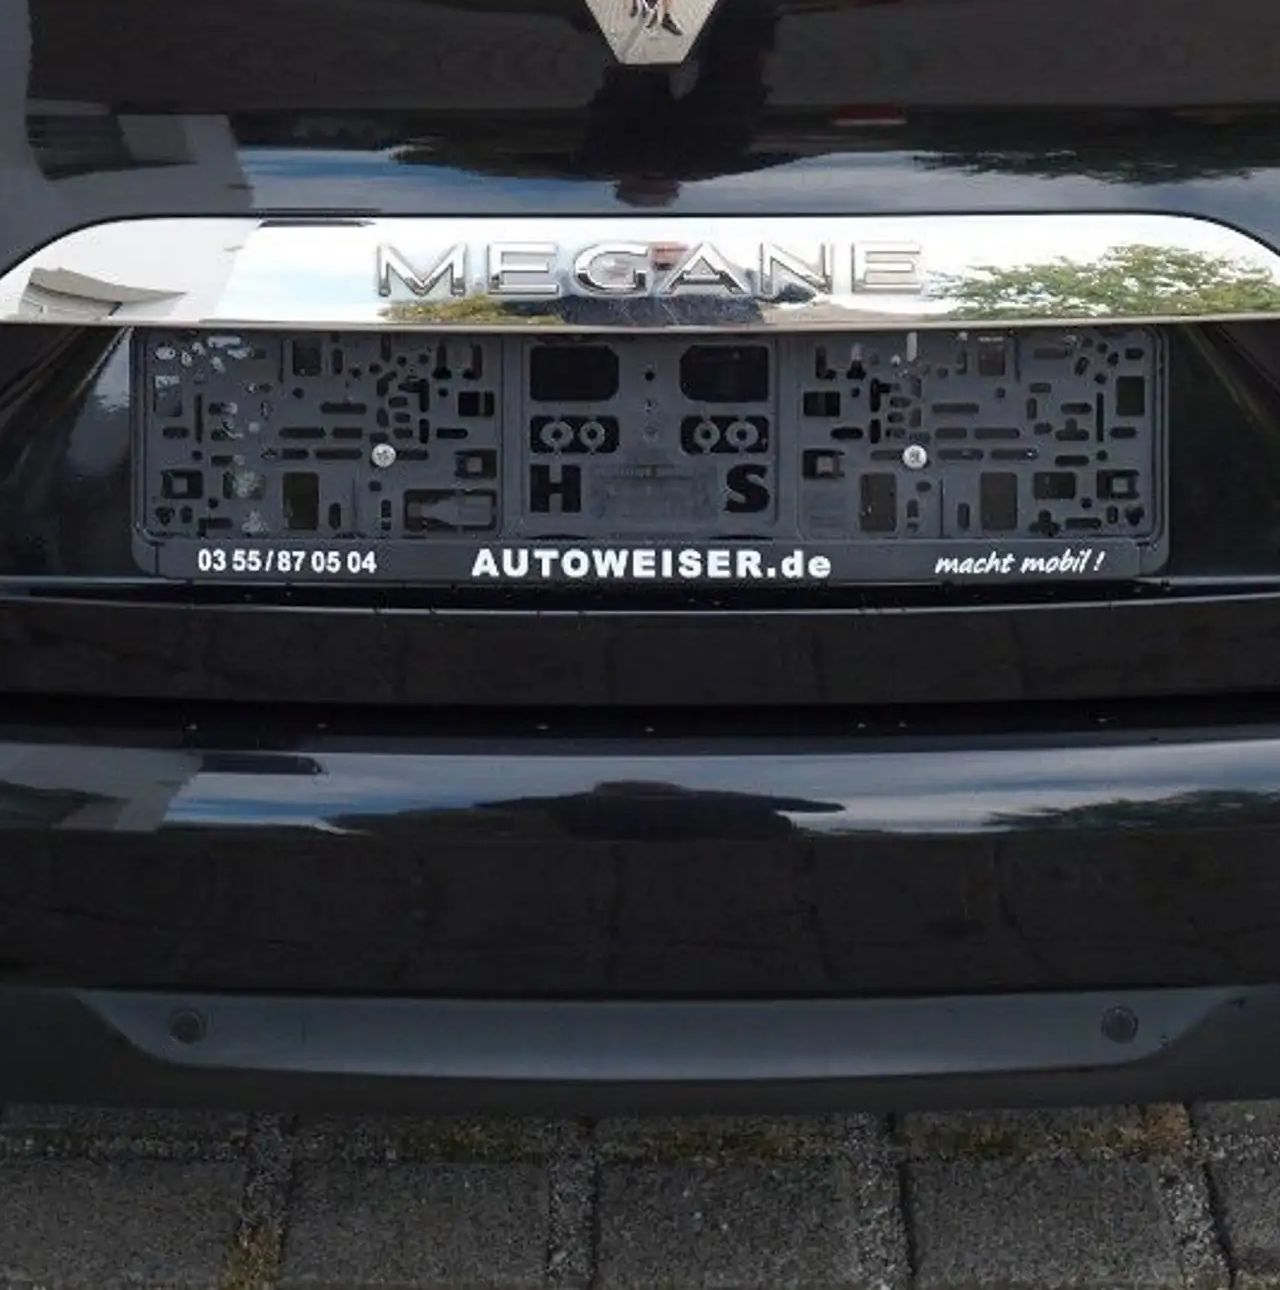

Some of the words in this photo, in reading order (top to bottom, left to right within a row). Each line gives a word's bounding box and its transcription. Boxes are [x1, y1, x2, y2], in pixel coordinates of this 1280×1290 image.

[376, 240, 921, 297] MEGANE
[529, 464, 582, 513] H
[723, 464, 770, 513] S
[198, 548, 227, 571] 03
[311, 550, 342, 573] 05
[347, 550, 377, 573] 04
[471, 548, 832, 579] AUTOWEISER.de
[934, 550, 1016, 574] macht
